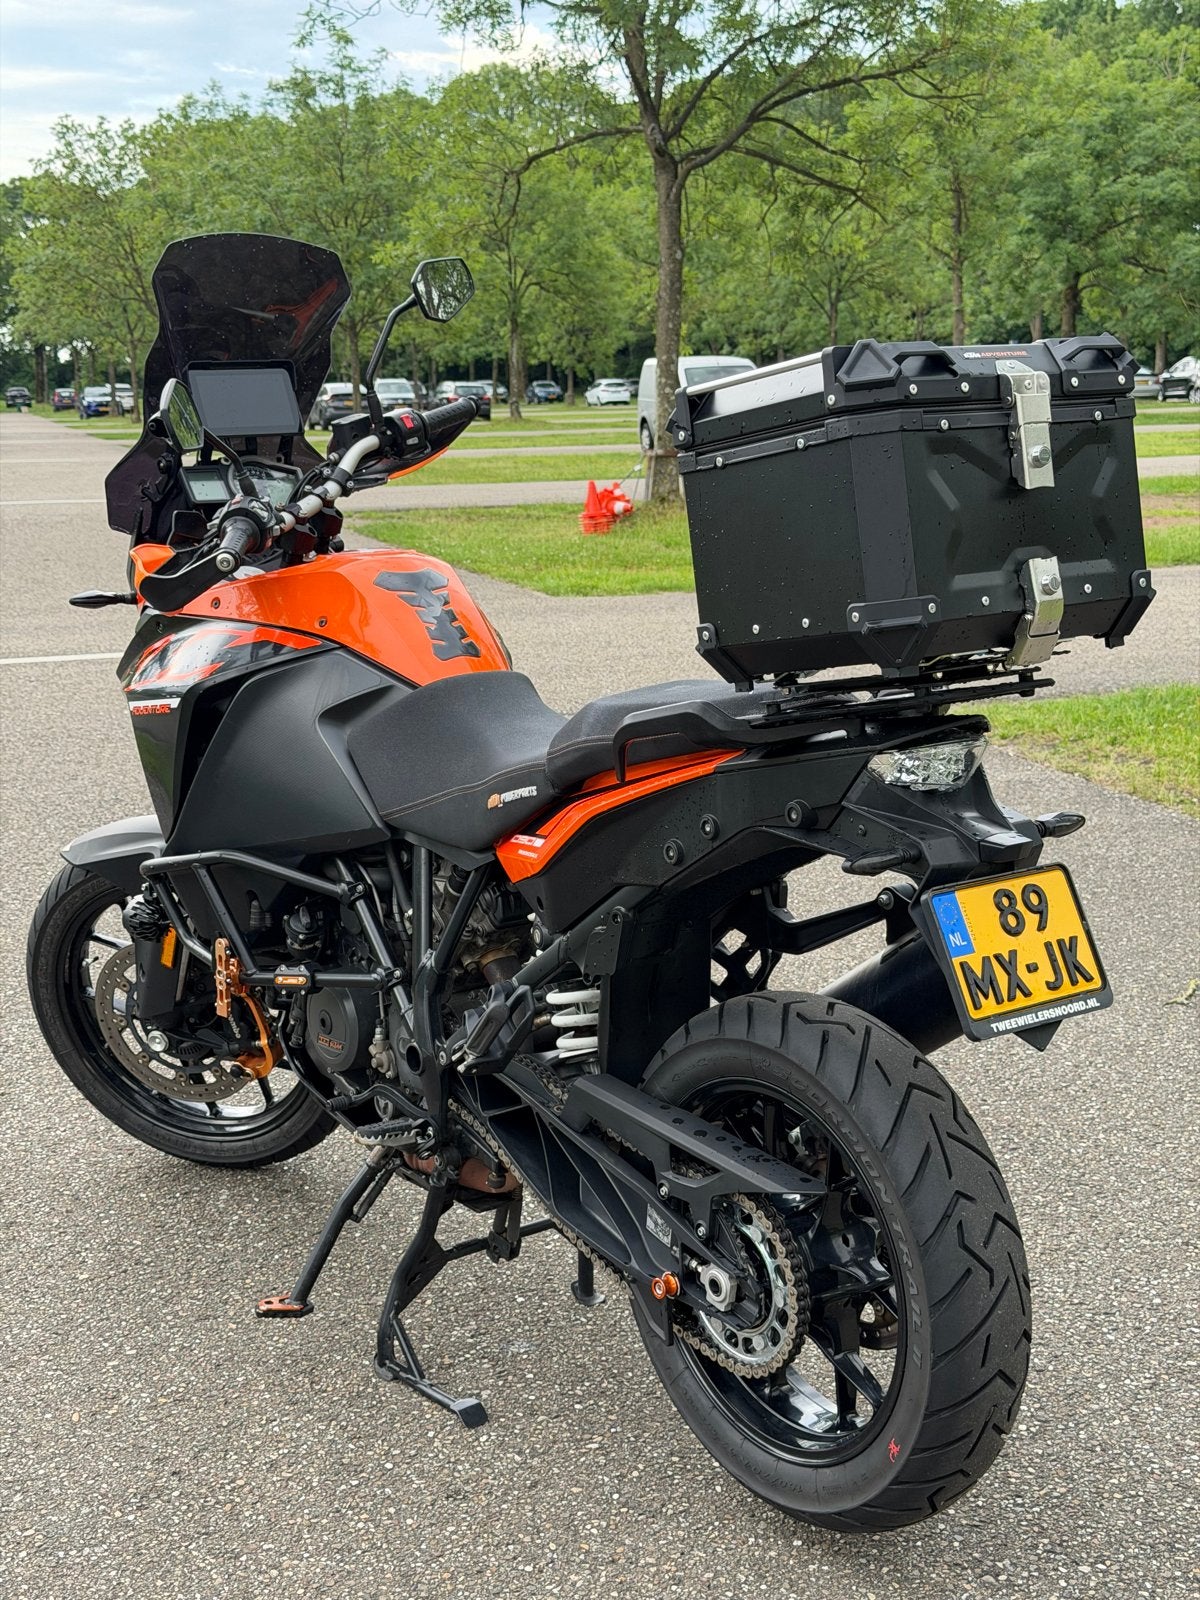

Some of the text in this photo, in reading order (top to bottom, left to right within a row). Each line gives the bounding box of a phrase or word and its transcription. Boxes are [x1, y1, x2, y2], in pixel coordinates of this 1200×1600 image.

[980, 350, 1029, 358] ADVENTURE
[993, 883, 1049, 938] 89
[949, 932, 967, 948] NL
[959, 935, 1095, 1011] MX-JK
[990, 997, 1100, 1033] TWEEWIELERSNOORD.NL
